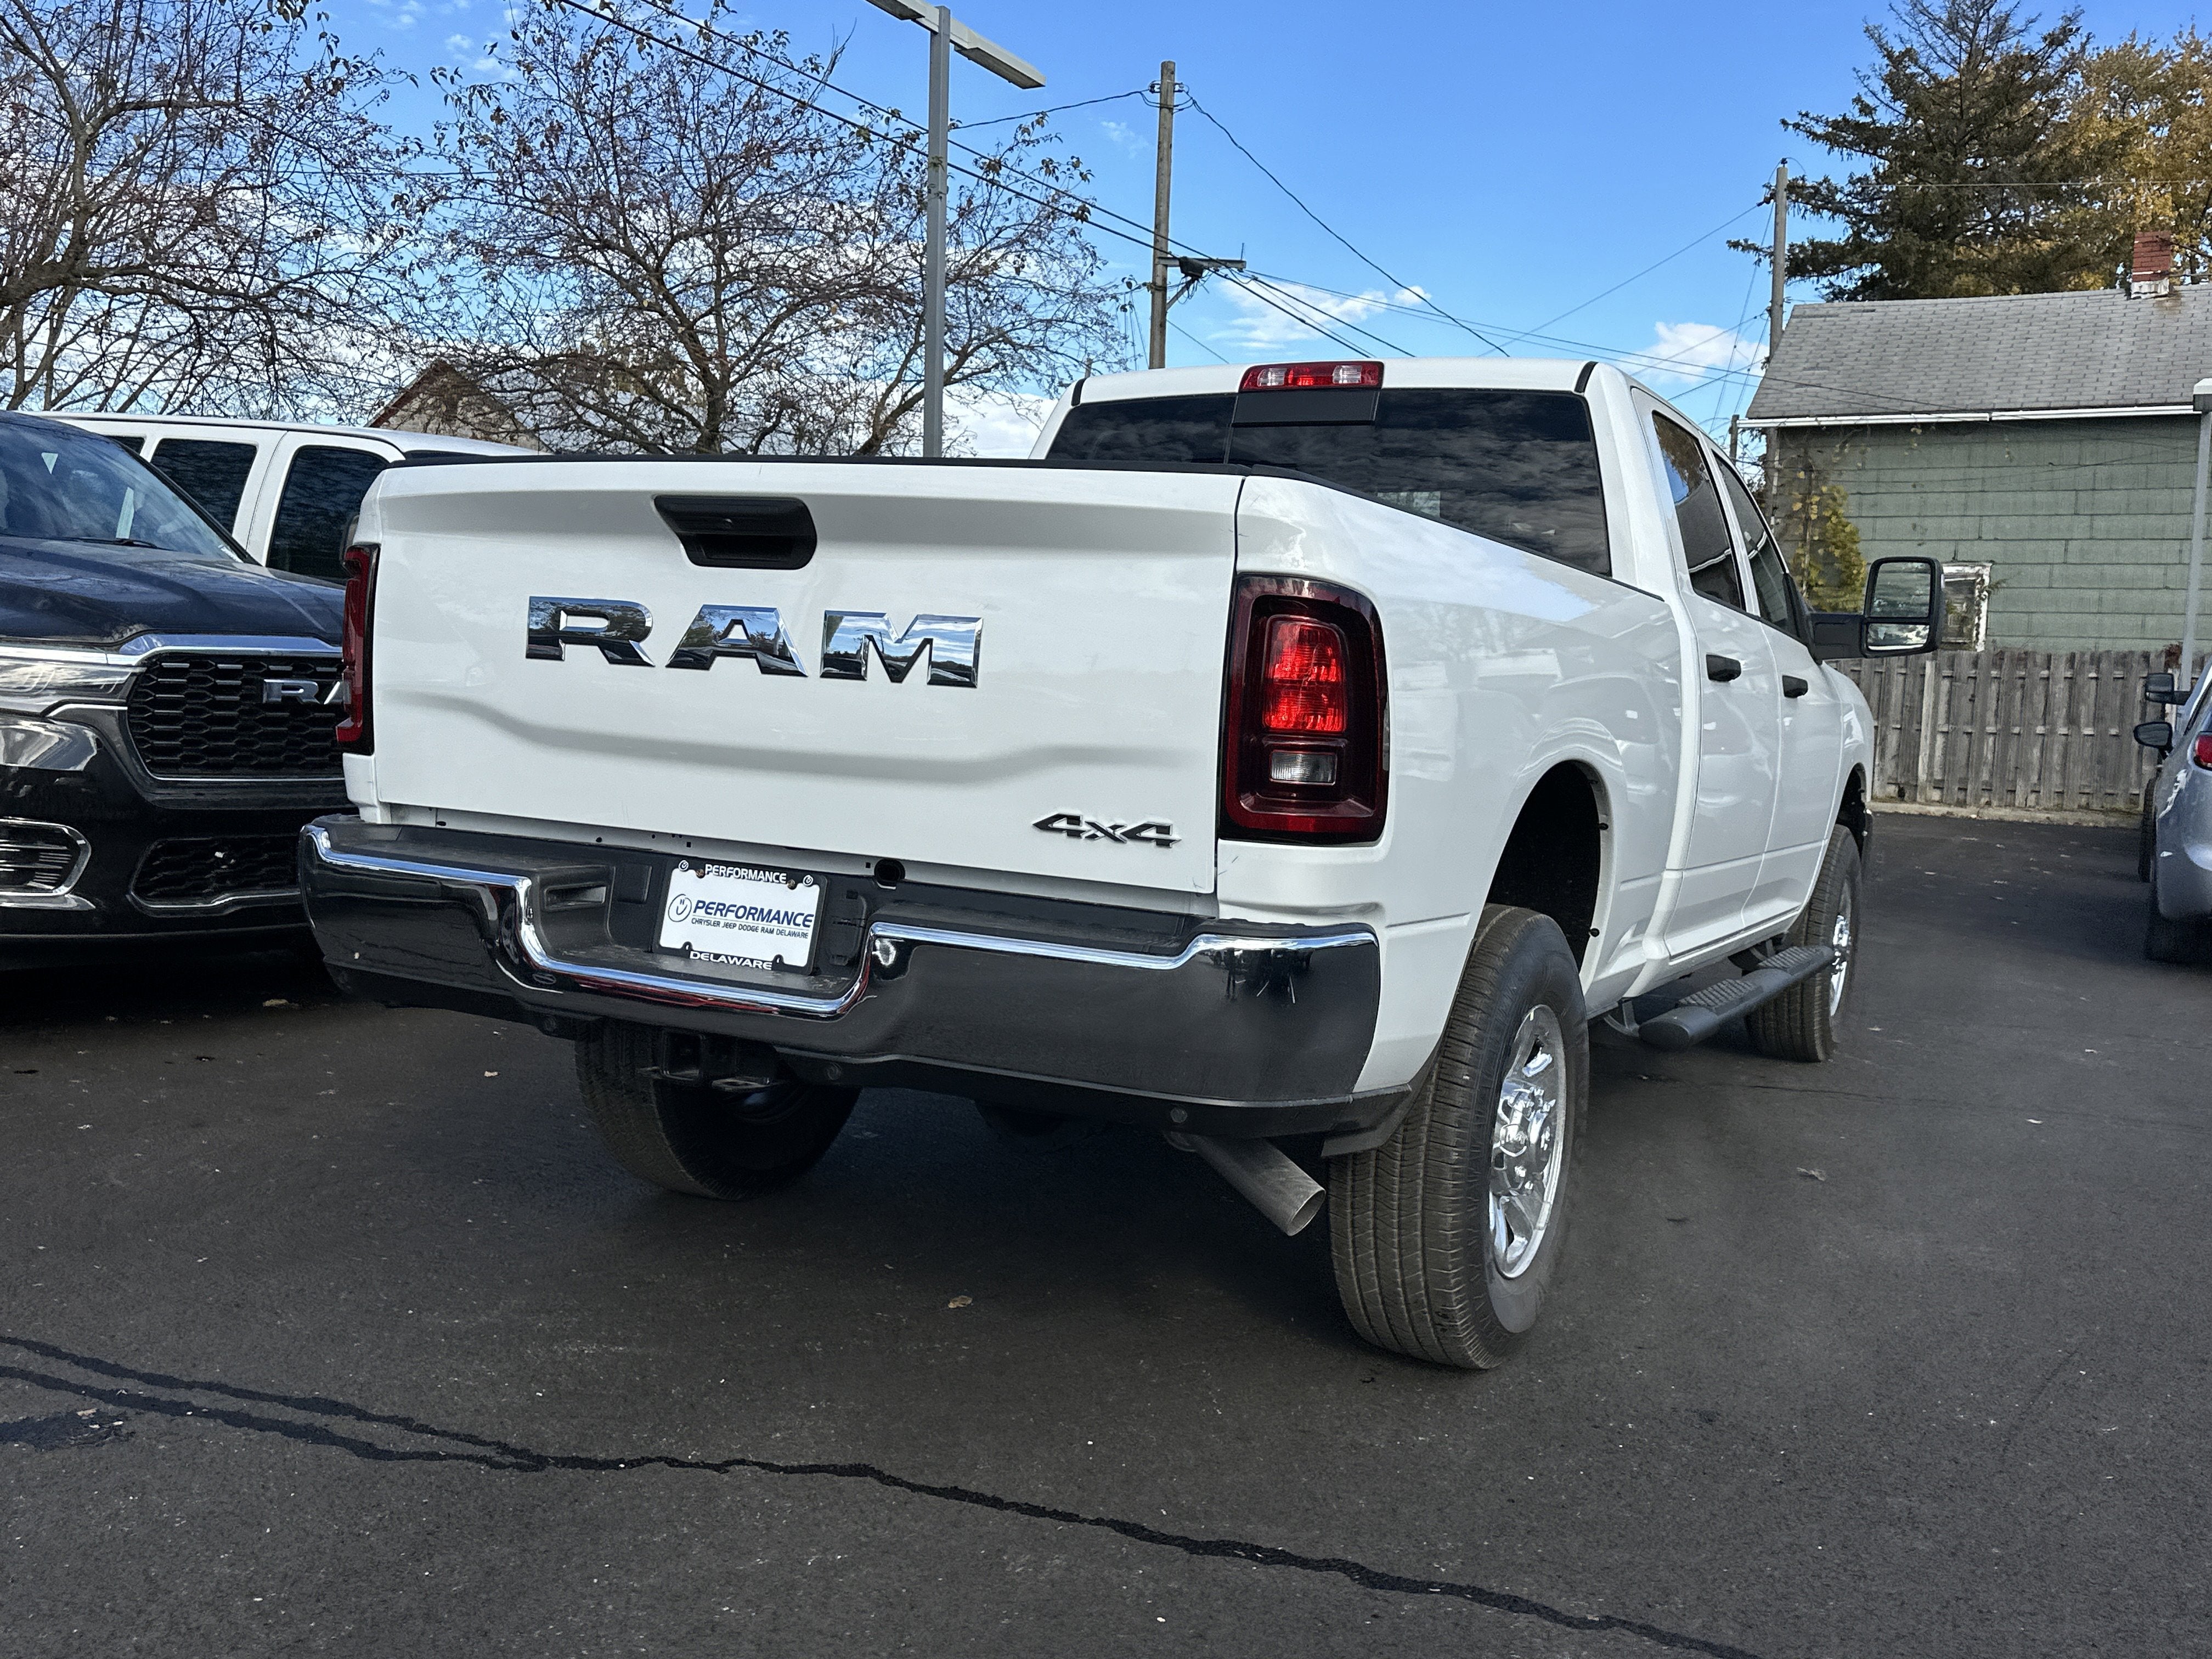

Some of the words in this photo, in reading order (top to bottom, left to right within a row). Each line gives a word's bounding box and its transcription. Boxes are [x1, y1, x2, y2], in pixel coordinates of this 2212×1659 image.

[526, 596, 983, 689] RAM
[705, 864, 787, 884] PERFORMANCE
[693, 900, 814, 928] PERFORMANCE
[691, 918, 720, 927] CHRYSLER
[738, 923, 759, 933] DODGE
[776, 929, 809, 939] DELAWARE
[690, 951, 772, 970] DELAWARE
